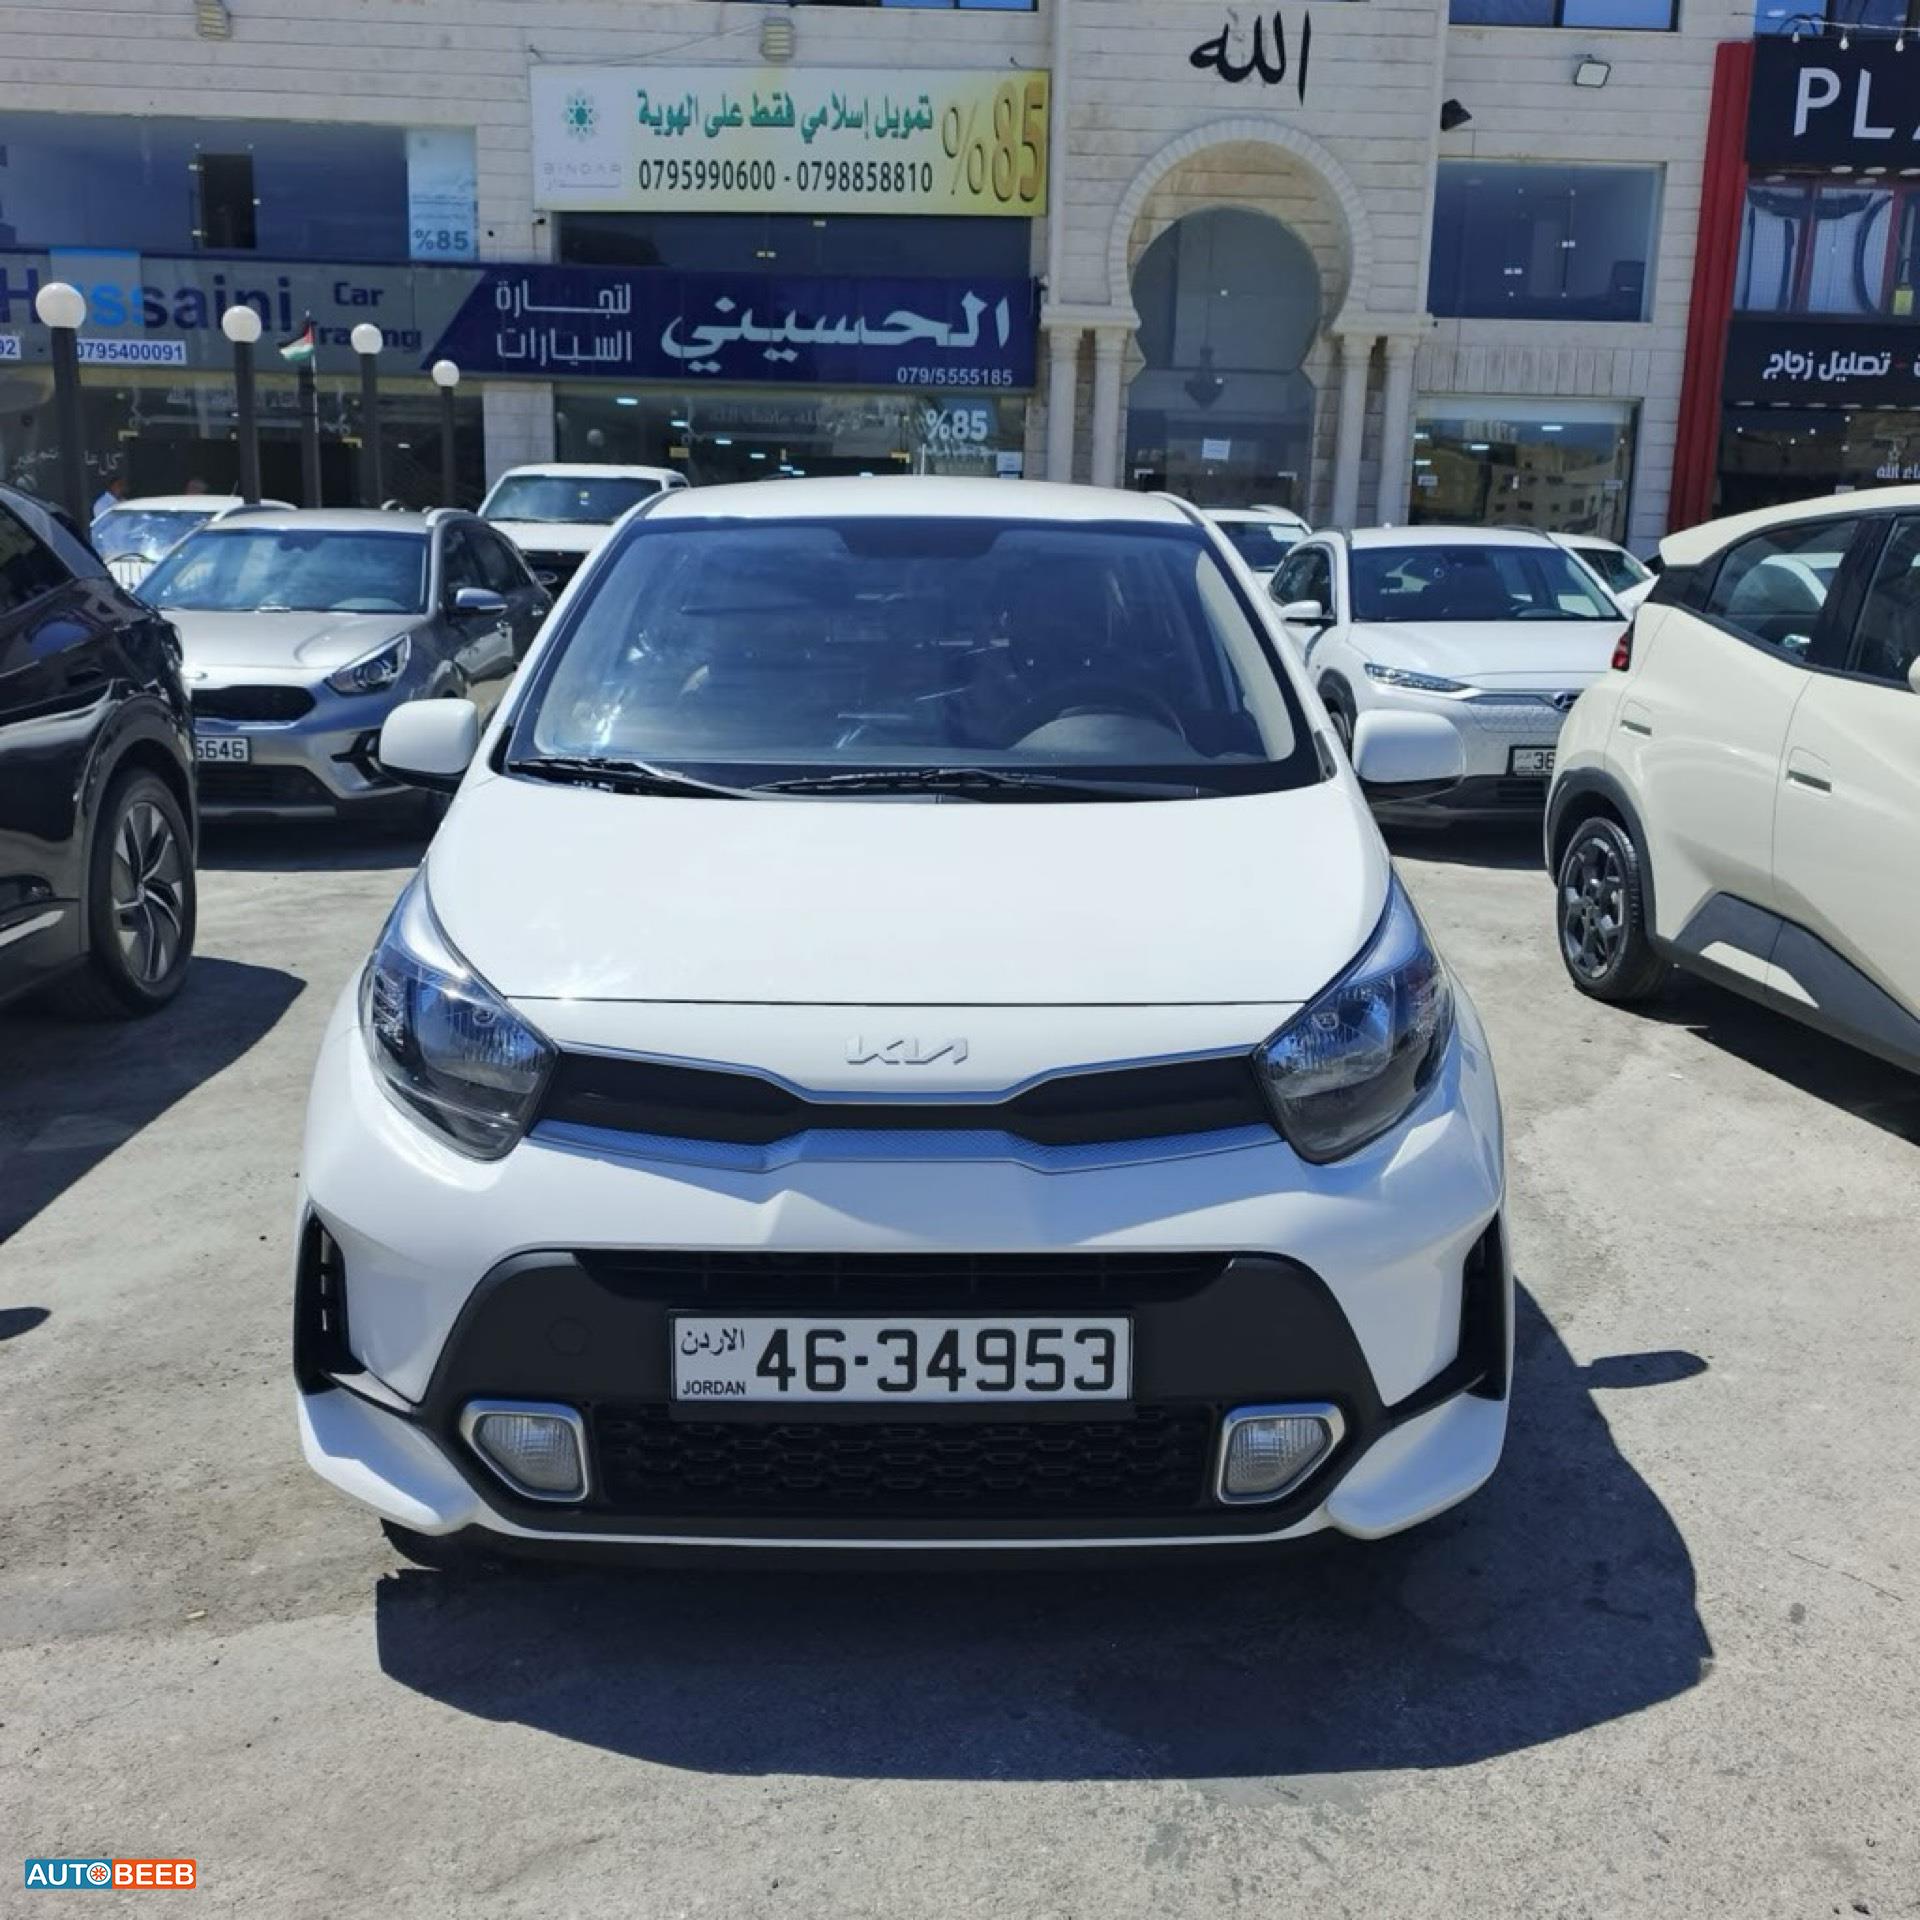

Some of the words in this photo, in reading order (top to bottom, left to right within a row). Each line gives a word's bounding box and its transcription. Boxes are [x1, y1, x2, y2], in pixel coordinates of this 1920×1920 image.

[1190, 8, 1311, 107] الله
[637, 88, 699, 136] الهوية
[705, 93, 743, 138] على
[750, 91, 795, 127] فقط
[801, 91, 869, 144] إسلامي
[875, 94, 933, 140] تمويل
[1793, 66, 1920, 140] PL
[942, 80, 1045, 202] %85
[638, 159, 775, 190] 0795990600
[797, 160, 933, 193] 0798858810
[415, 228, 469, 251] %85
[0, 267, 292, 333] Hssaini
[333, 282, 384, 307] Car
[496, 279, 631, 319] لتجارة
[496, 327, 632, 367] السيارات
[661, 290, 1010, 373] الحسيني
[897, 366, 1013, 386] 079/5555185
[1762, 350, 1814, 381] زجاج
[925, 408, 988, 441] %85
[756, 1328, 1115, 1392] 46-34953
[682, 1380, 746, 1395] JORDAN
